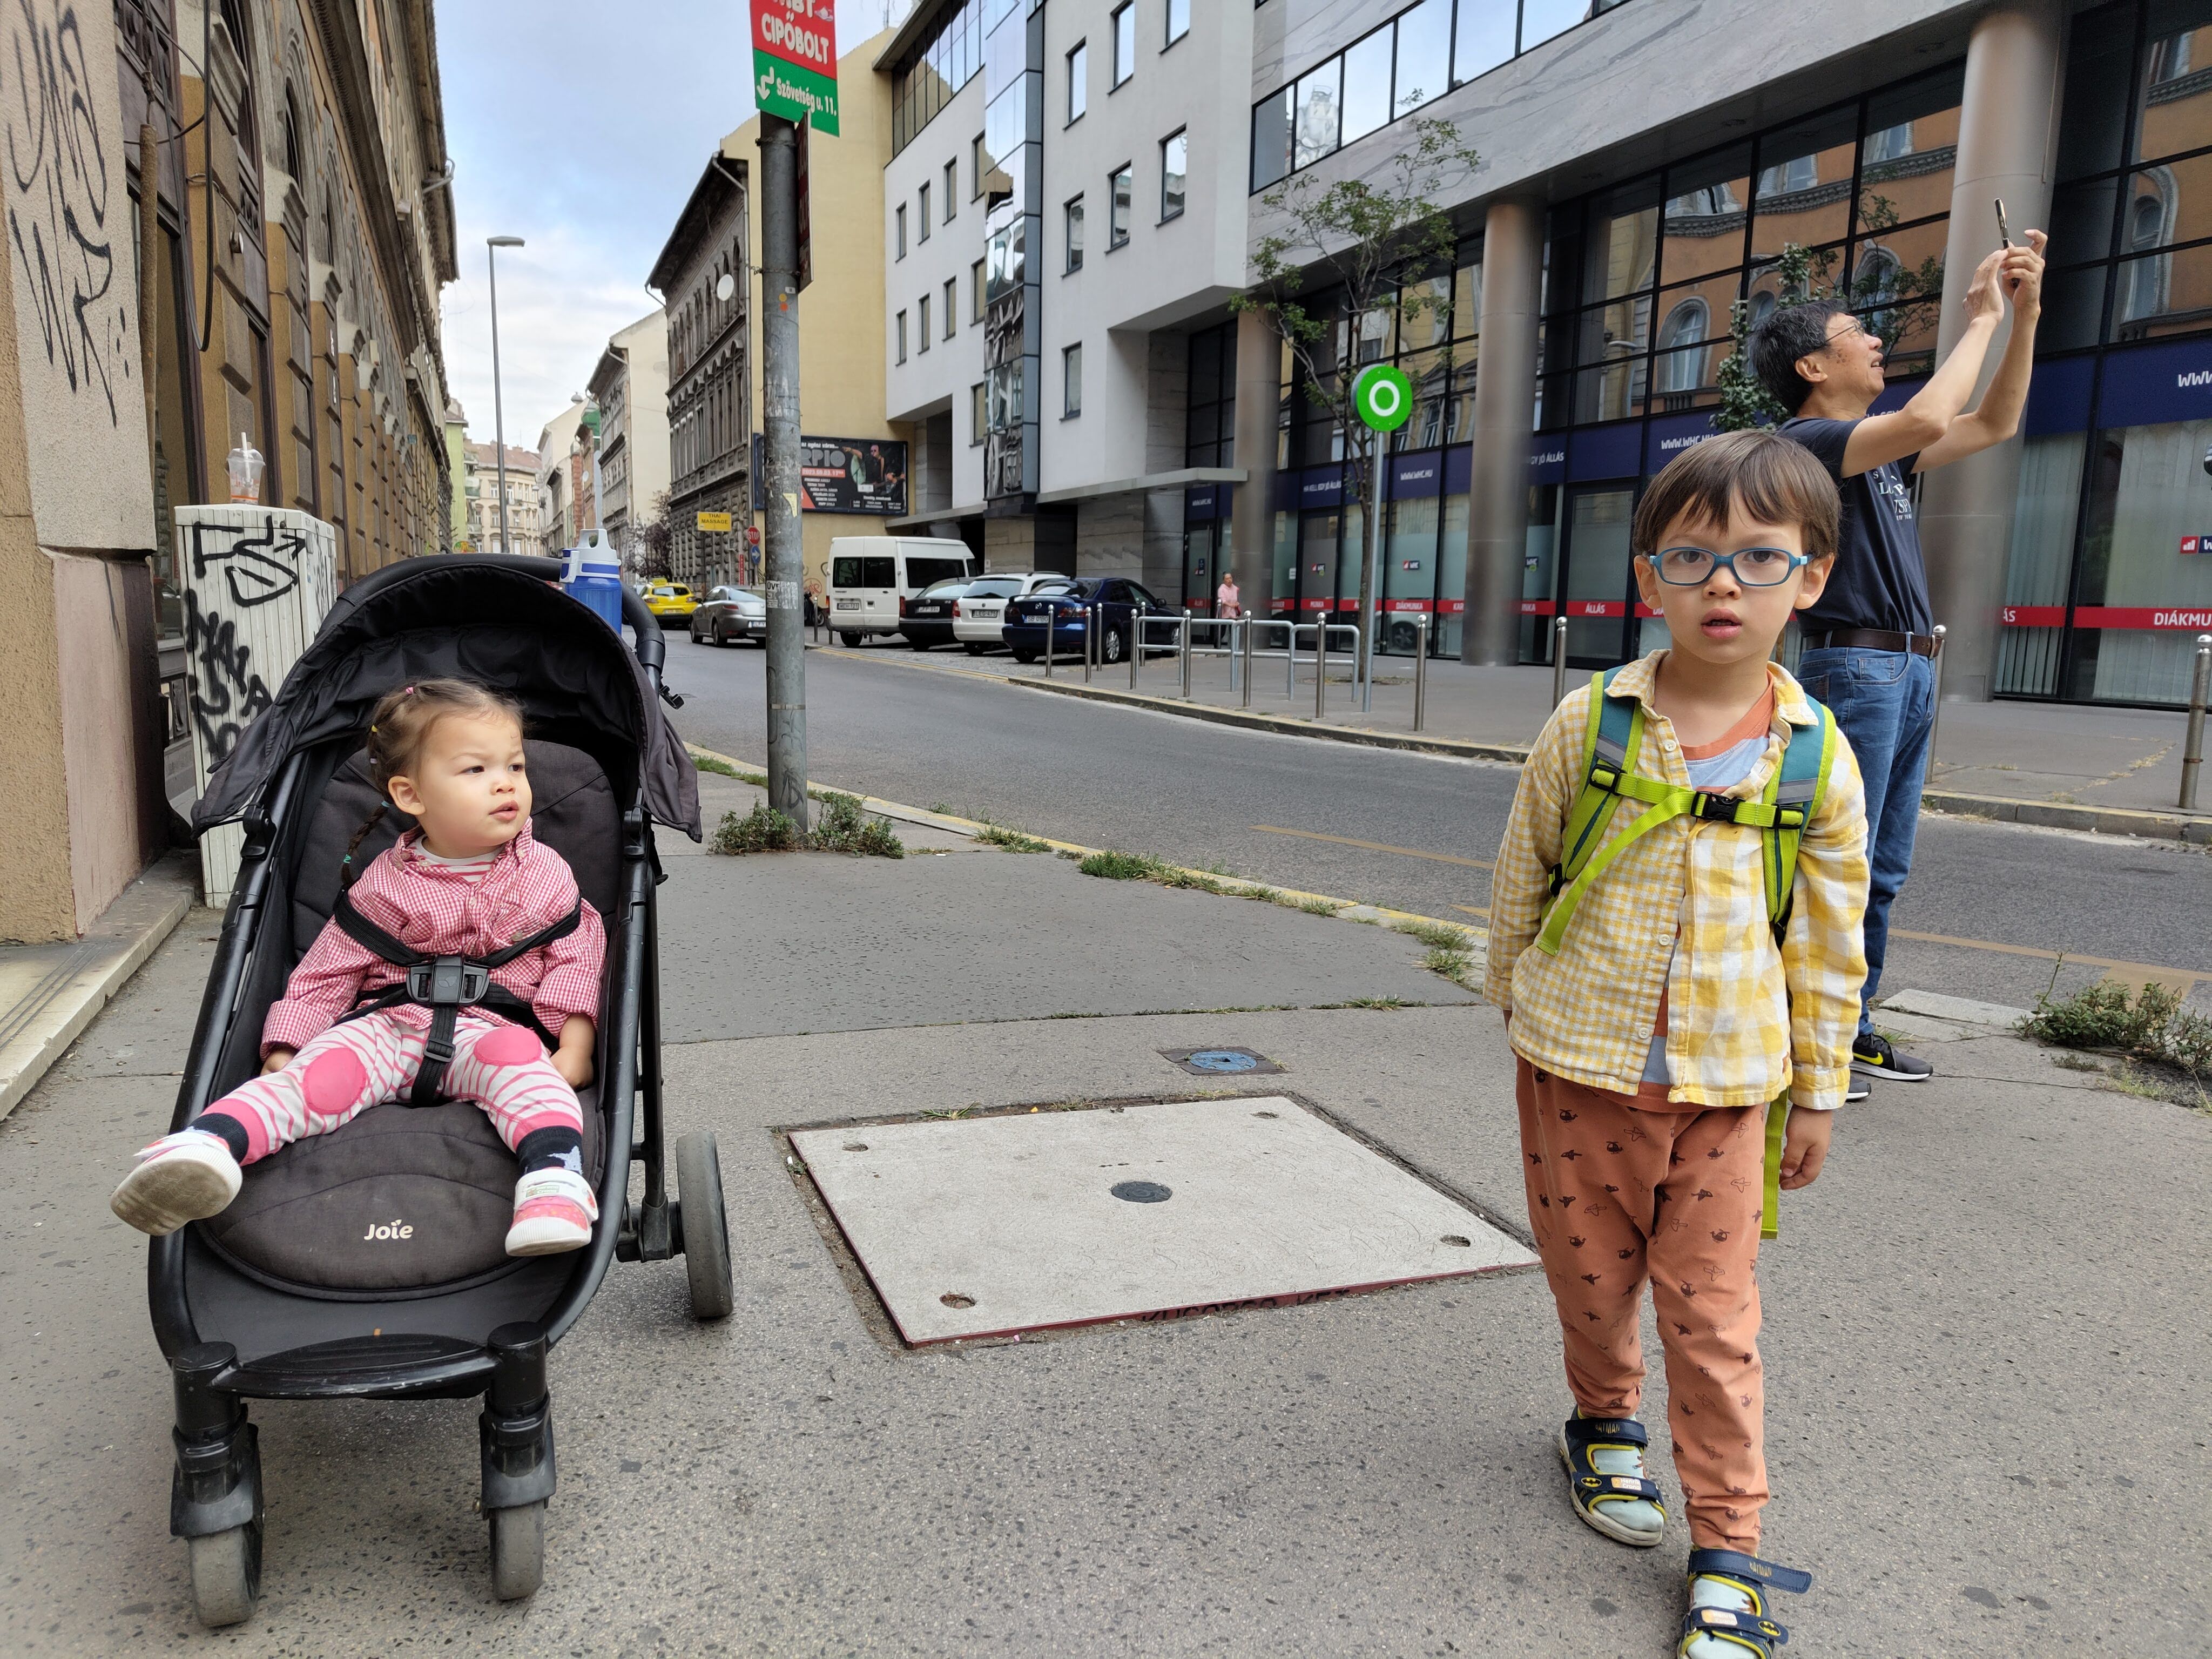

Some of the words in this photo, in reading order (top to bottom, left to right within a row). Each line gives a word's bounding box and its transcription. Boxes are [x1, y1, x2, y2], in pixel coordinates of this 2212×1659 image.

[761, 10, 829, 64] CIPŐBOLT
[777, 77, 815, 113] Szövetség
[816, 96, 823, 111] u.
[825, 95, 837, 117] 11.
[801, 449, 846, 467] RPIO
[1546, 450, 1564, 463] ÁLLÁS
[748, 531, 760, 540] STOP
[1585, 603, 1606, 615] ÁLLÁS
[2154, 610, 2212, 626] DIÁKMU
[363, 1219, 414, 1240] Joie
[1595, 1421, 1620, 1434] BATMAN
